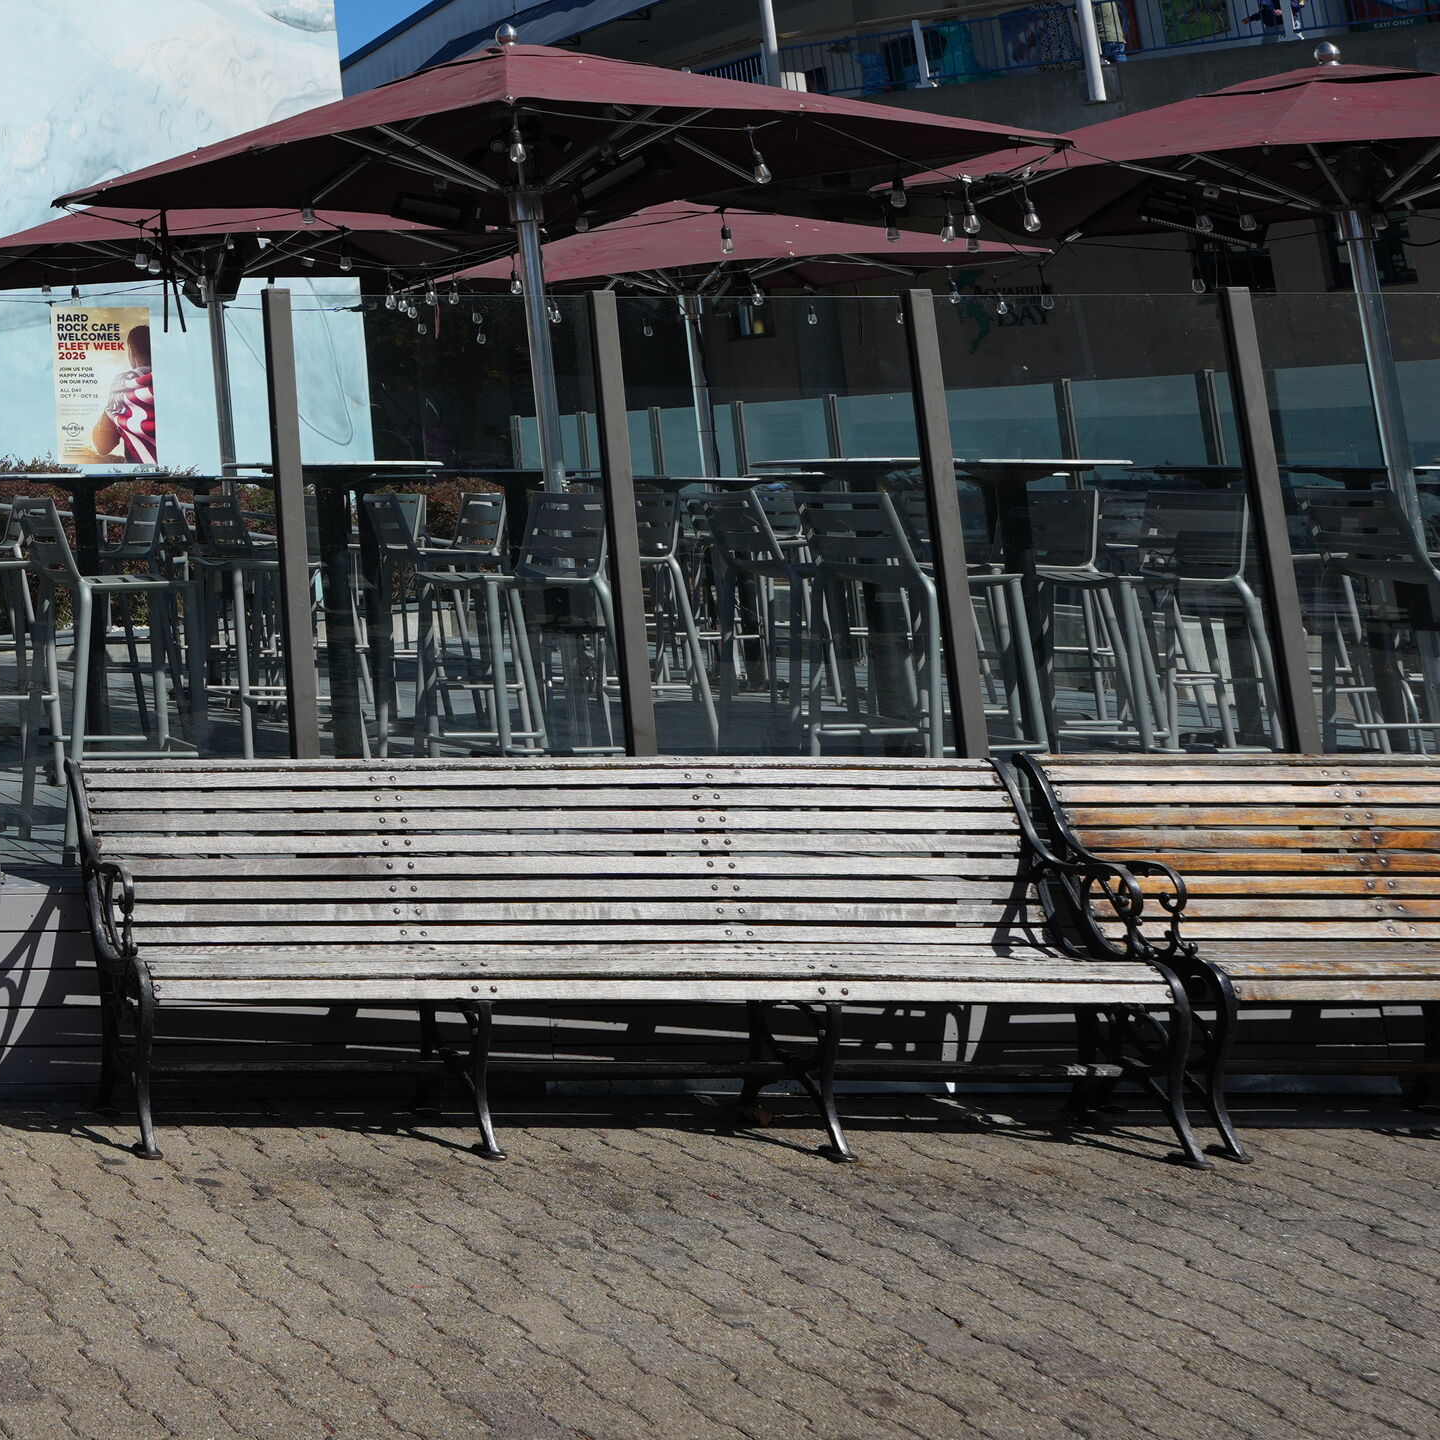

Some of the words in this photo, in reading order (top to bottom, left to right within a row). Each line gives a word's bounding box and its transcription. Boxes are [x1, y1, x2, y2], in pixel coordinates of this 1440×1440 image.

[974, 286, 1052, 299] AQUARIU
[57, 314, 89, 322] HARD
[57, 323, 88, 331] ROCK
[91, 323, 120, 331] CAFE
[57, 333, 120, 341] WELCOMES
[58, 342, 90, 350] FLEET
[93, 342, 125, 350] WEEK
[58, 351, 86, 360] 2026
